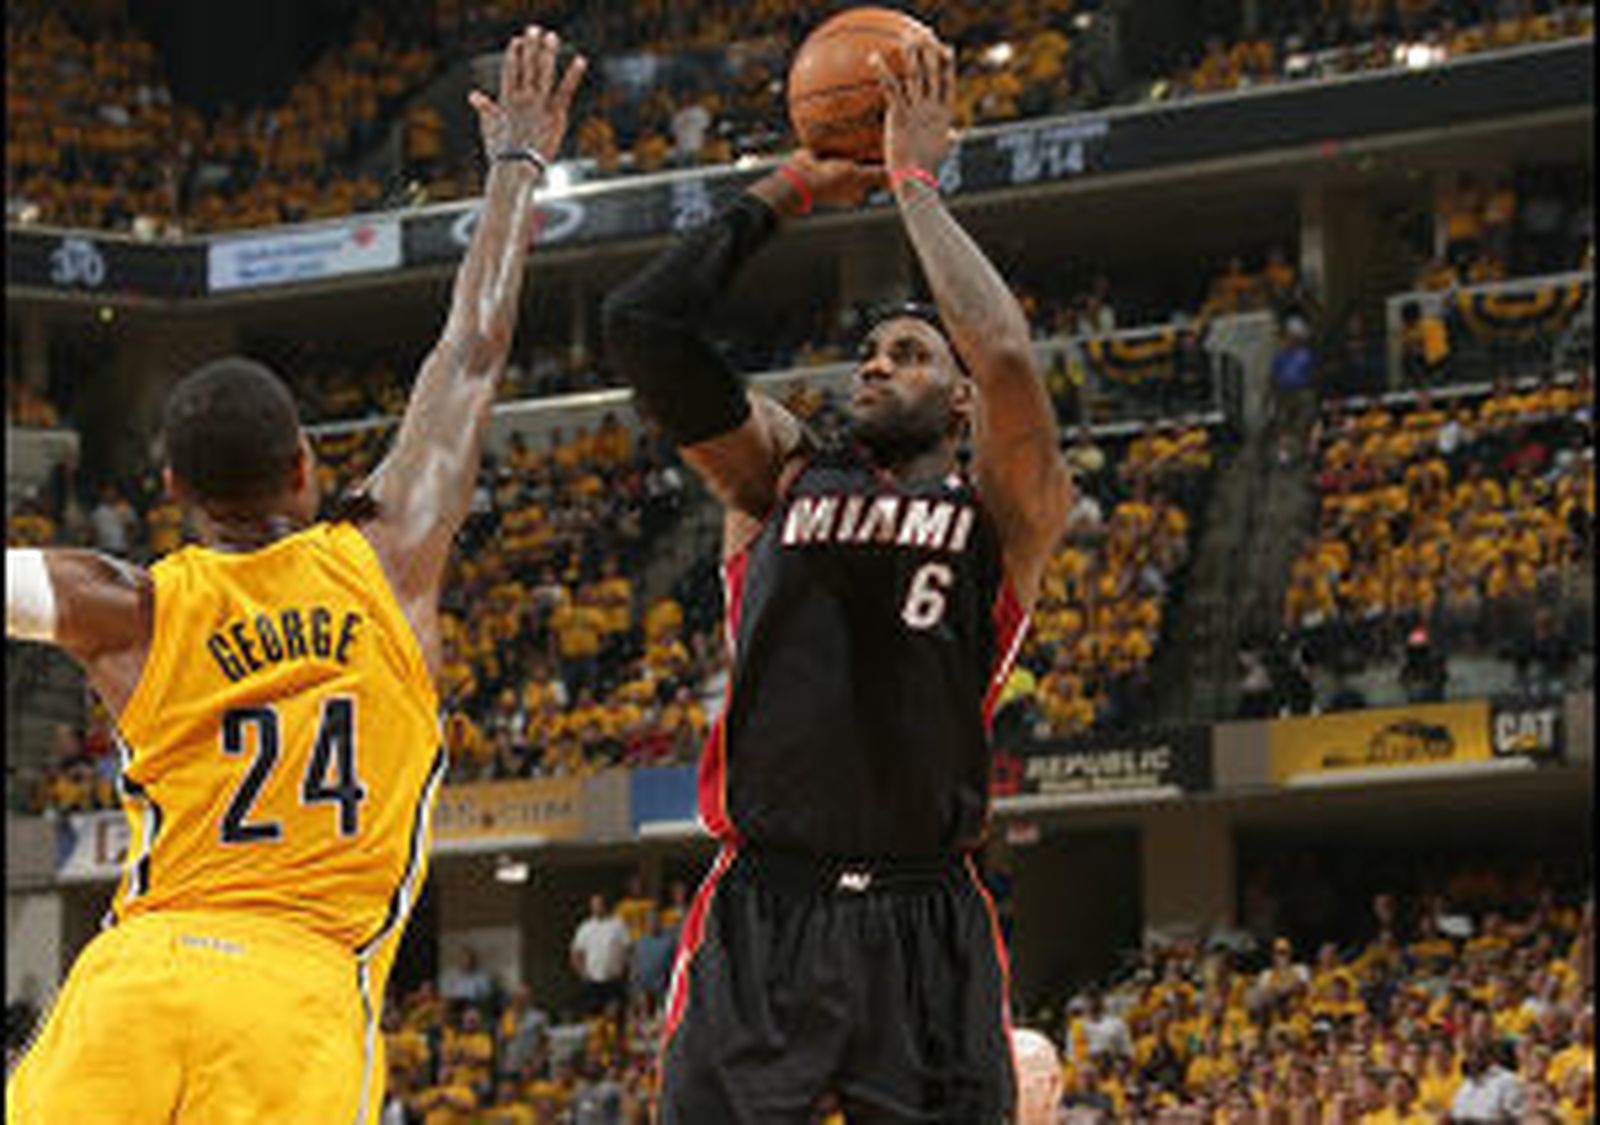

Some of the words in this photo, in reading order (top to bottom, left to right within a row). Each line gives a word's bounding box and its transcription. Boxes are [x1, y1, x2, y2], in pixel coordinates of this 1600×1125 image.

[781, 495, 974, 551] MIAMI
[901, 561, 953, 629] 6
[206, 607, 363, 683] GEORGE
[1494, 709, 1556, 752] CAT
[218, 697, 366, 842] 24
[1025, 747, 1171, 780] REPUBLIC
